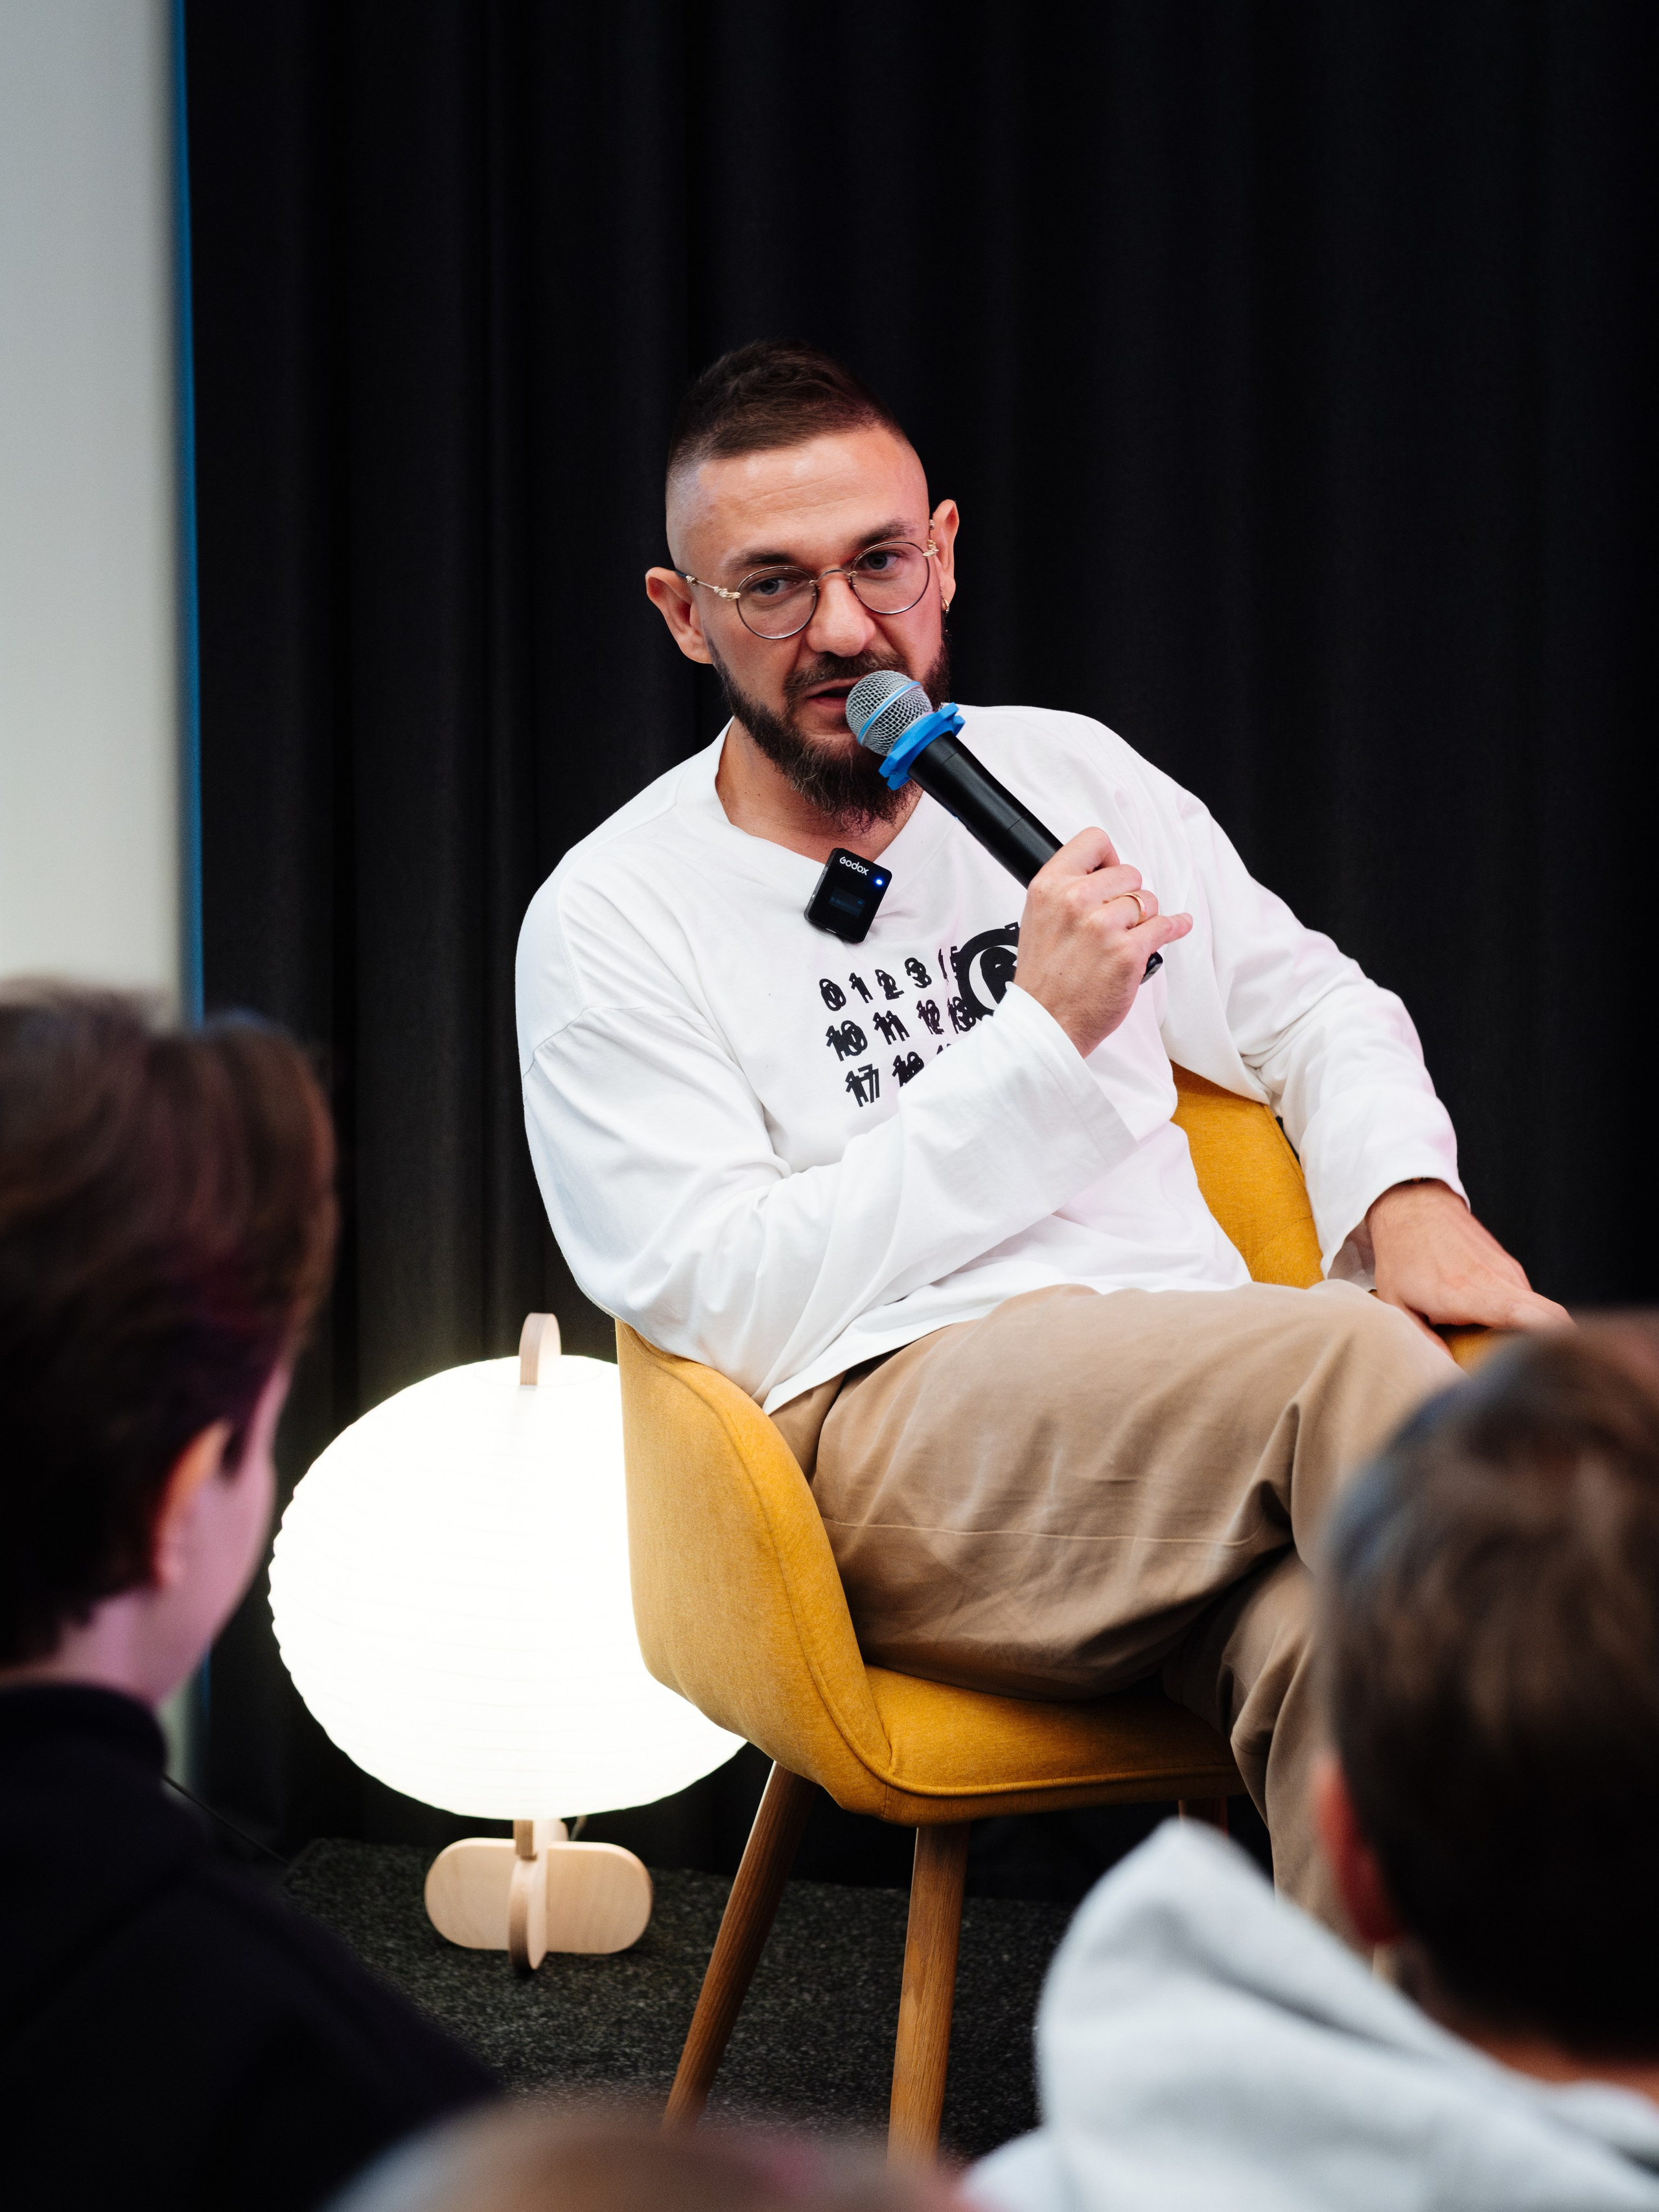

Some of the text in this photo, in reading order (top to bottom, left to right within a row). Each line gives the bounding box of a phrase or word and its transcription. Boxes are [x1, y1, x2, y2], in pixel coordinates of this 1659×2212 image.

[839, 856, 869, 876] Godox
[819, 978, 846, 1011] 0
[849, 972, 874, 1003] 1
[875, 969, 905, 1000] 2
[904, 957, 933, 988] 3
[825, 1020, 868, 1062] 10
[872, 1010, 911, 1045] 11
[916, 999, 944, 1034] 12
[844, 1063, 880, 1107] 17
